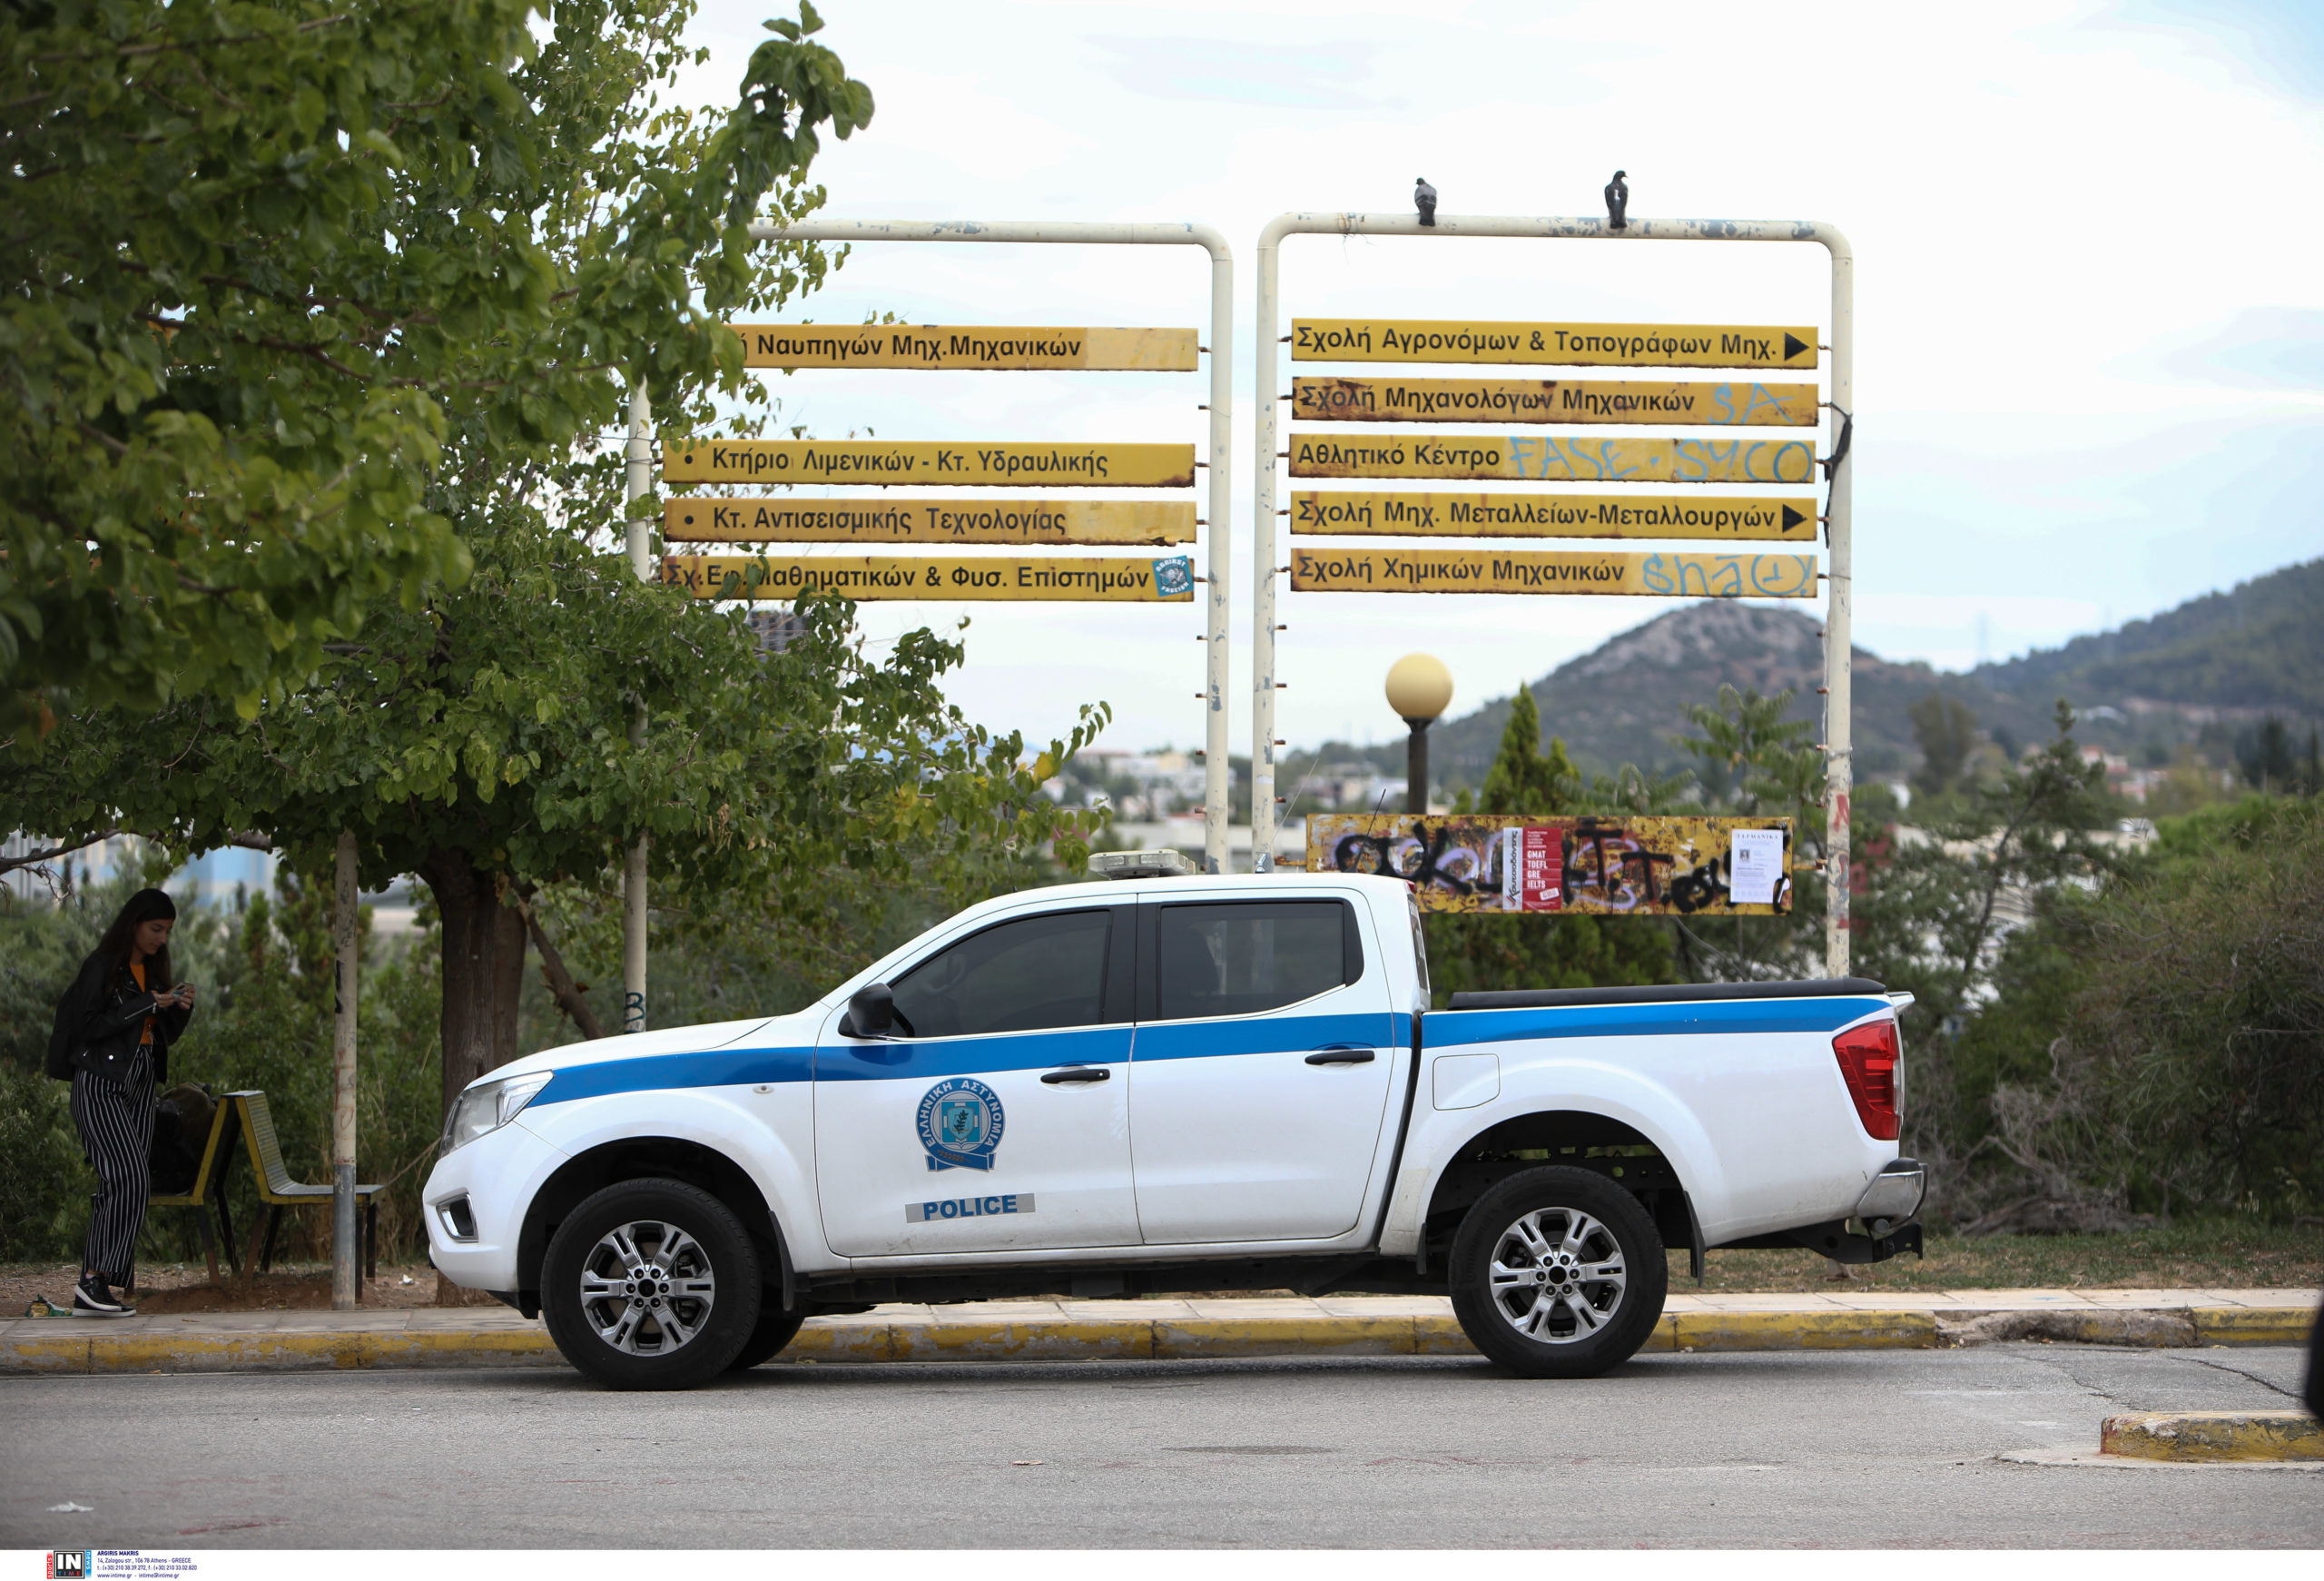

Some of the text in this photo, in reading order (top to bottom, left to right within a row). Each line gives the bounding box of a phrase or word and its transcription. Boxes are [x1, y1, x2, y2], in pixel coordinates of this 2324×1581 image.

[758, 333, 883, 361] Ναυπηγών
[1297, 326, 1777, 361] Σχολή Αγρονόμων & Τοπογράφων Μηχ.
[1301, 385, 1695, 416] Σχολή Μηχανολόγων Μηχανικών
[713, 447, 789, 475] Κτήριο
[803, 449, 915, 476] Λιμενικών
[938, 450, 970, 471] Κτ.
[978, 450, 1108, 479] Υδραυλικής
[1297, 443, 1500, 471] Αθλητικό Κέντρο
[714, 507, 1067, 536] Κτ. Αντισεισμικής Τεχνολογίας
[1298, 499, 1775, 531] Σχολή Μηχ. Μεταλλείων-Μεταλλουργών
[925, 566, 941, 587] &
[950, 565, 1008, 588] Φυσ.
[1018, 566, 1149, 593] Επιστημών
[1298, 556, 1624, 586] Σχολή Χημικών Μηχανικών
[1527, 850, 1547, 859] GMAT
[1527, 860, 1548, 869] TOEFL
[1527, 870, 1541, 878] GRE
[1527, 880, 1546, 889] IELTS
[920, 1080, 1003, 1148] ΕΛΛΗΝΙΚΗ ΑΣΤΥΝΟΜΙΑ
[922, 1194, 1018, 1220] POLICE
